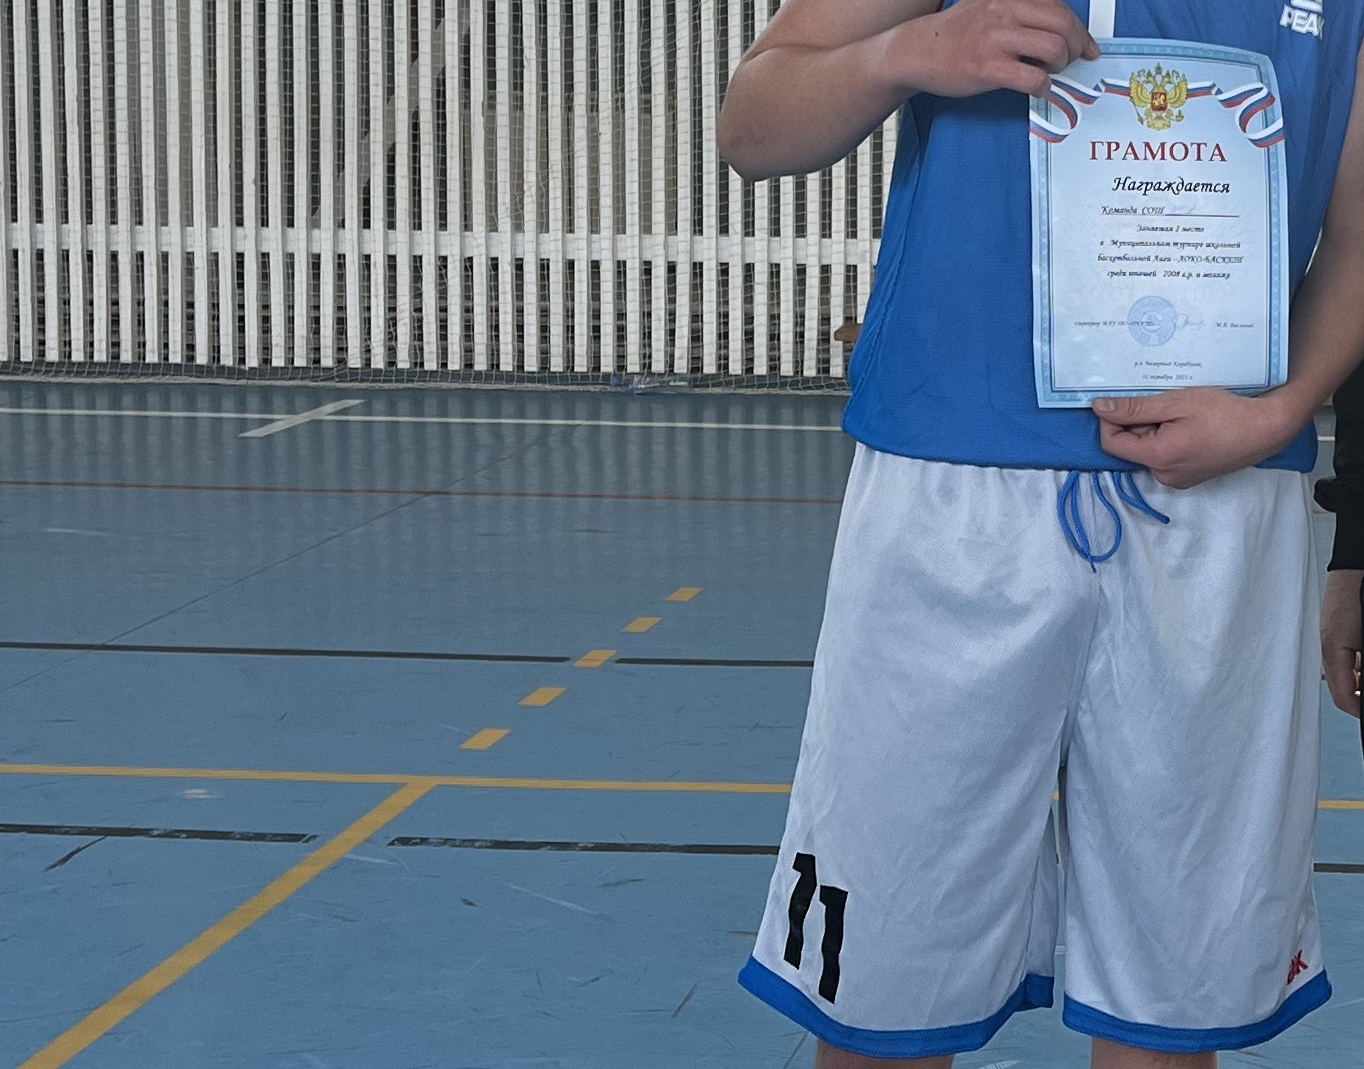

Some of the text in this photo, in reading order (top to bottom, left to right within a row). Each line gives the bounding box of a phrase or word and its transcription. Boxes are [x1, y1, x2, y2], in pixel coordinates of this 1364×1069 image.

[1089, 141, 1228, 163] ГРАМОТА
[1111, 176, 1231, 196] Награждается
[1100, 206, 1138, 215] Команда
[783, 851, 849, 1005] 11
